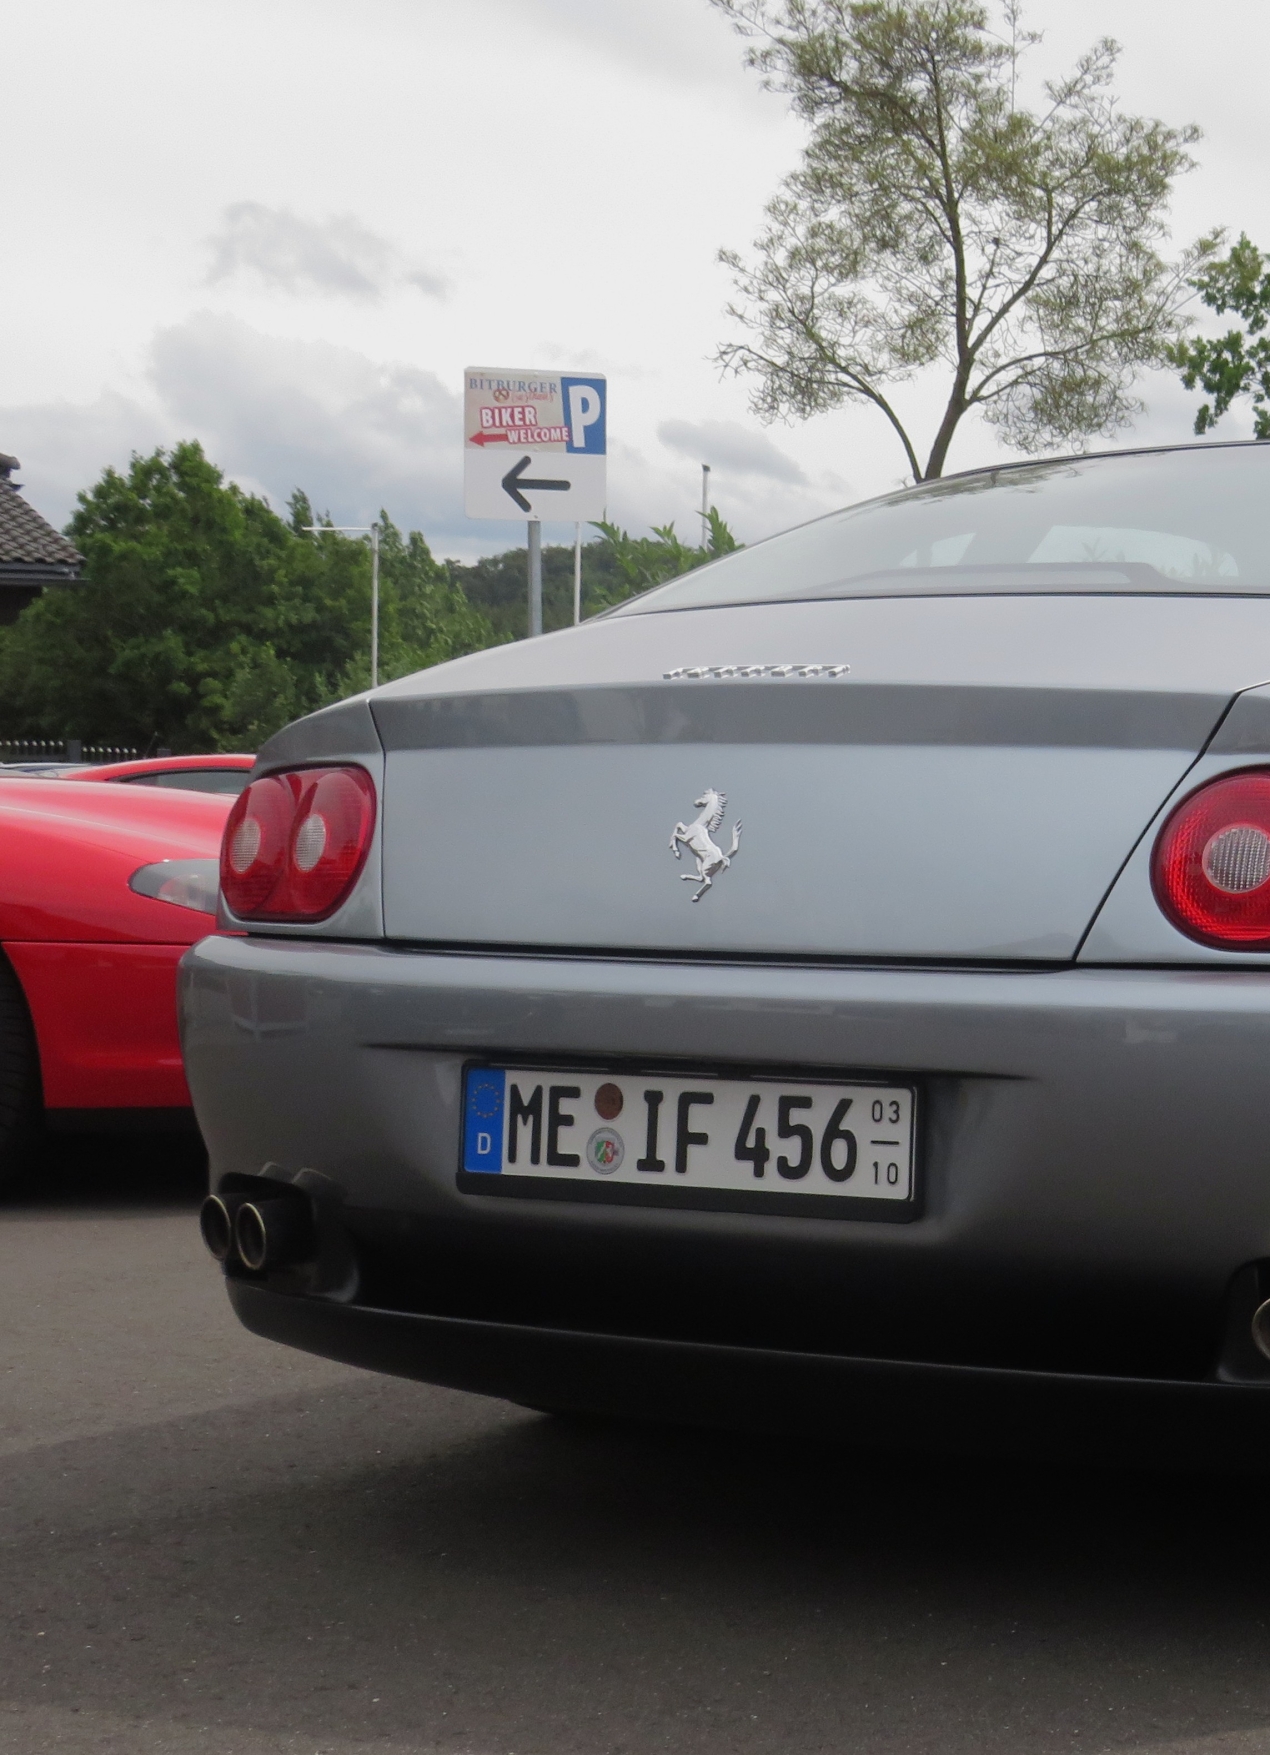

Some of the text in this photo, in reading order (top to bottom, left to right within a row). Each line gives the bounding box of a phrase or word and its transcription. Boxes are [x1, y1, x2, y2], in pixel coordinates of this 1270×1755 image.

[469, 378, 558, 394] BITBURGER
[481, 406, 537, 427] BIKER
[568, 385, 601, 448] P
[507, 427, 569, 443] WELCOME
[871, 1100, 900, 1124] 03
[477, 1132, 492, 1155] D
[508, 1084, 581, 1167] ME
[636, 1089, 714, 1174] IF
[734, 1094, 858, 1182] 456
[872, 1161, 899, 1186] 10
